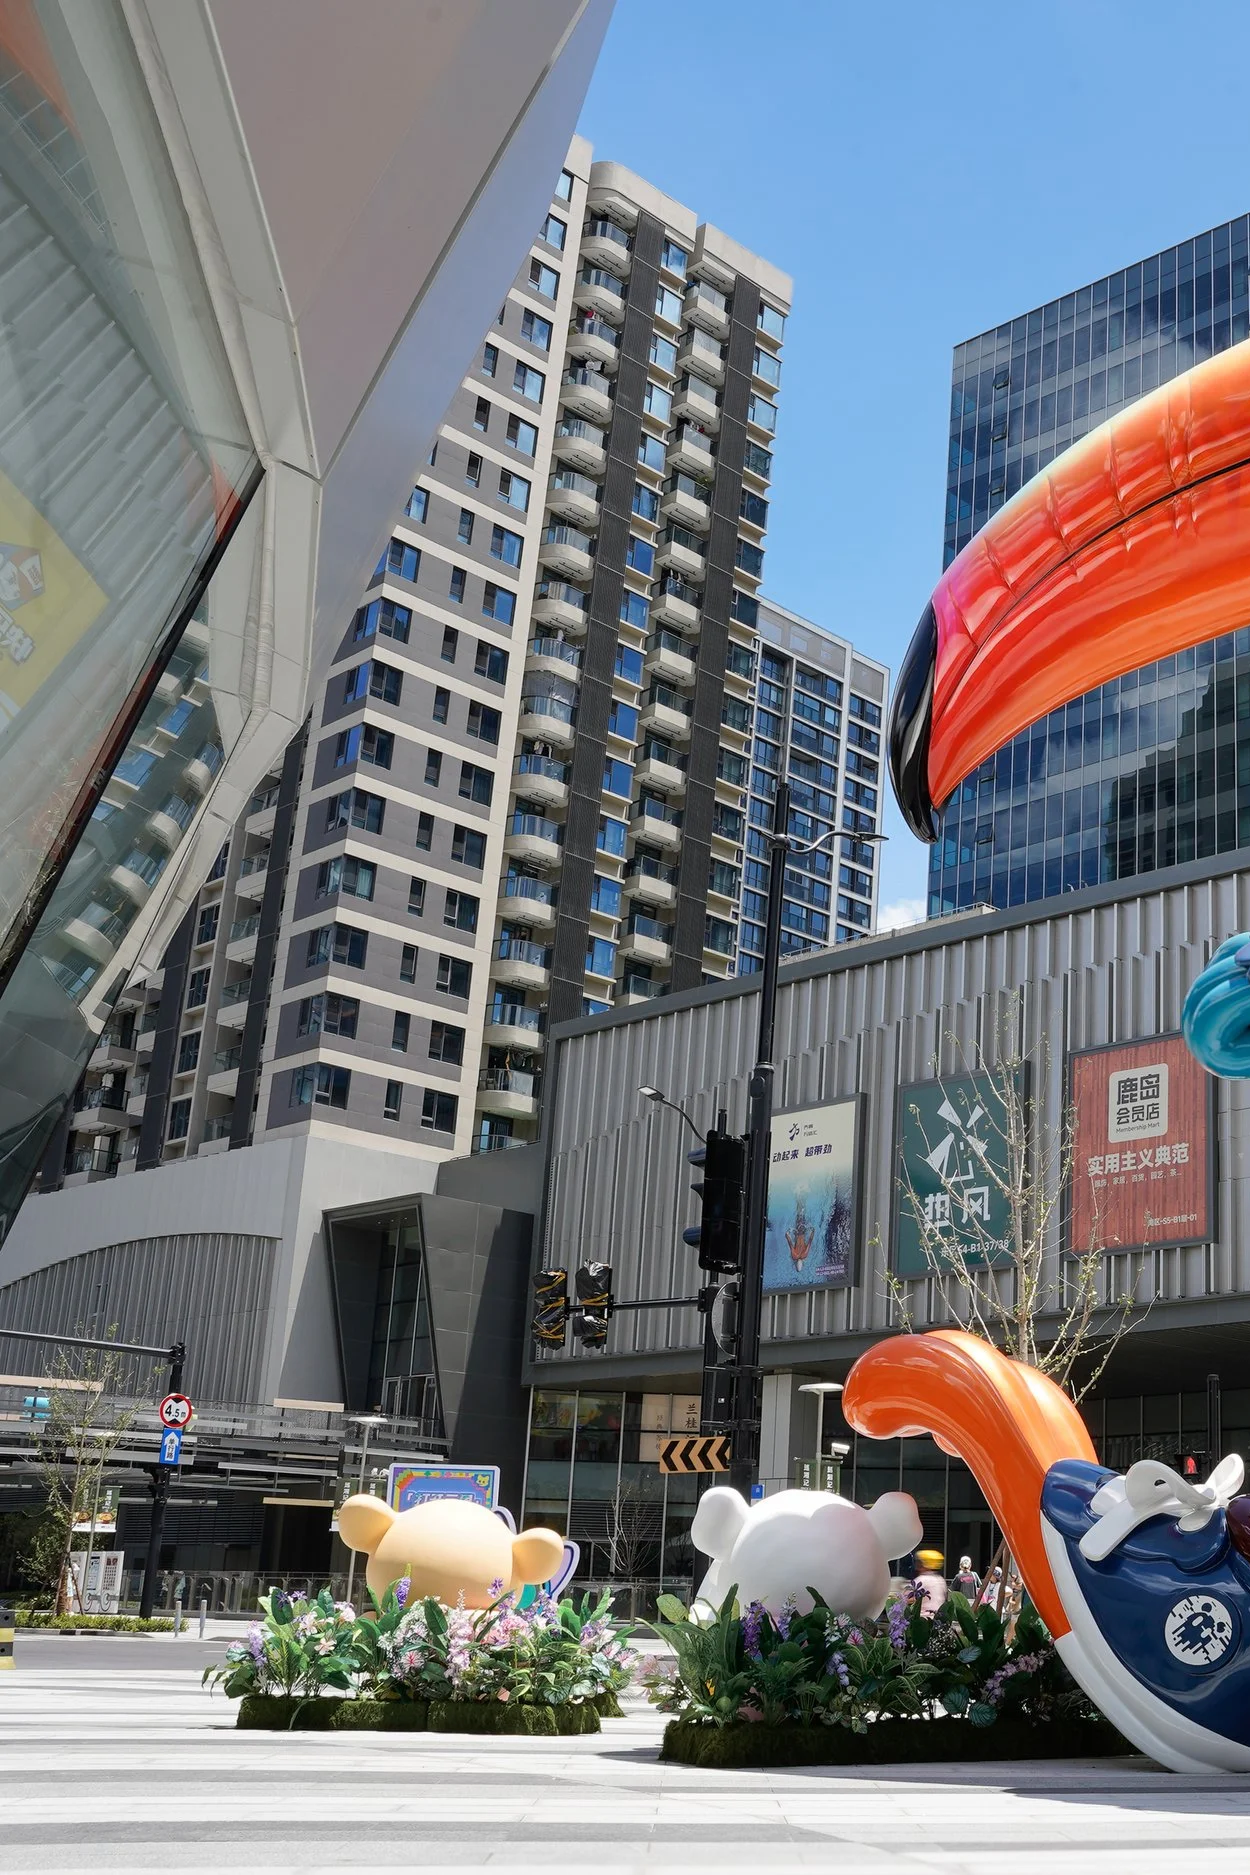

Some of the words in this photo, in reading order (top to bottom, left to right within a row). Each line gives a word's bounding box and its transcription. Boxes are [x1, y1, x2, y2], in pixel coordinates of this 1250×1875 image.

[1117, 1073, 1160, 1105] 鹿岛
[1117, 1103, 1160, 1125] 会员店
[1116, 1124, 1147, 1133] Membership
[773, 1149, 799, 1162] 动起来
[1088, 1142, 1189, 1177] 实用主义典范
